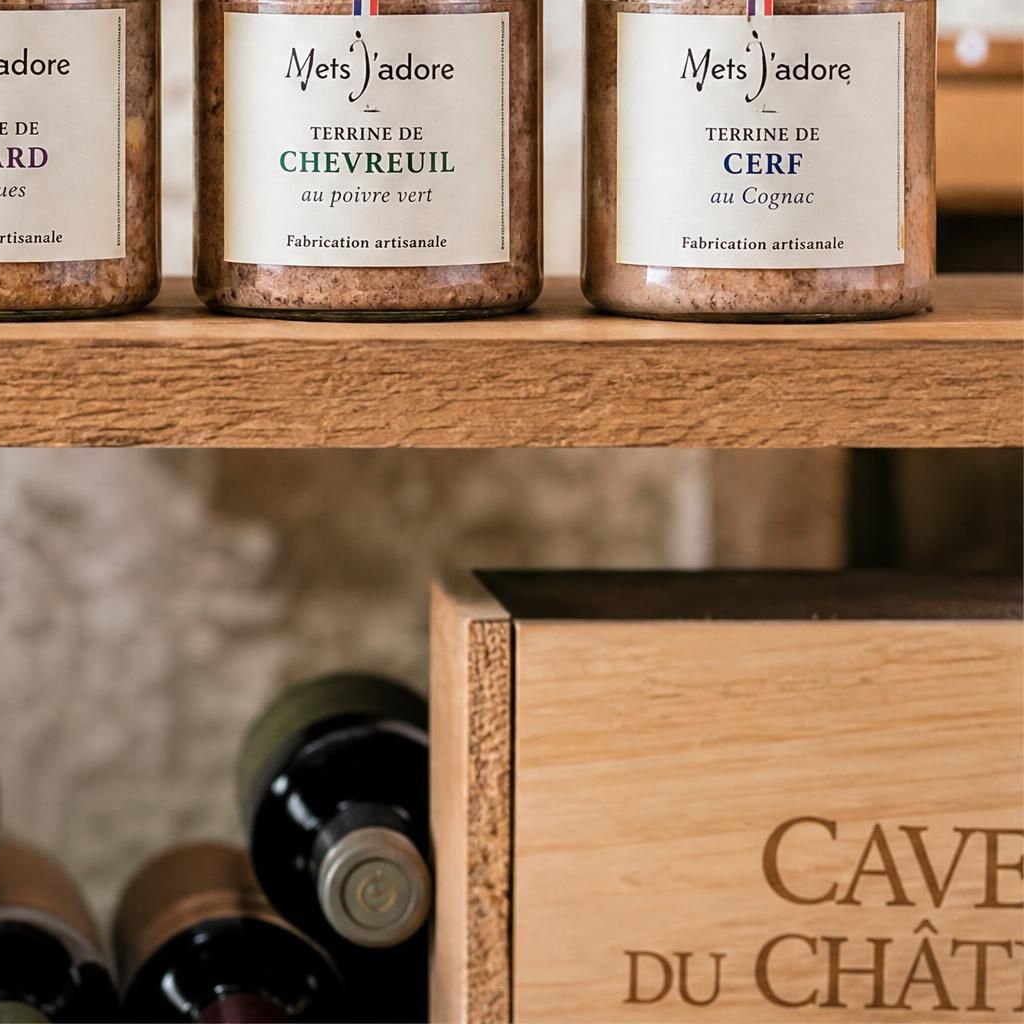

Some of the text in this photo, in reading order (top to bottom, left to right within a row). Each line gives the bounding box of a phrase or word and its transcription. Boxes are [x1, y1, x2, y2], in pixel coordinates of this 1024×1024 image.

[284, 46, 351, 92] Mets
[679, 47, 748, 93] Mets
[15, 121, 40, 136] DE
[309, 125, 424, 141] TERRINE DE
[705, 127, 821, 142] TERRINE DE
[279, 150, 456, 174] CHEVREUIL
[722, 152, 804, 176] CERF
[301, 185, 433, 208] au poivre vert
[709, 186, 815, 211] au Cognac
[285, 234, 448, 250] Fabrication artisanale
[680, 236, 845, 251] Fabrication artisanale
[761, 815, 1024, 909] CAVE
[622, 918, 1024, 1013] DU CHÂT
